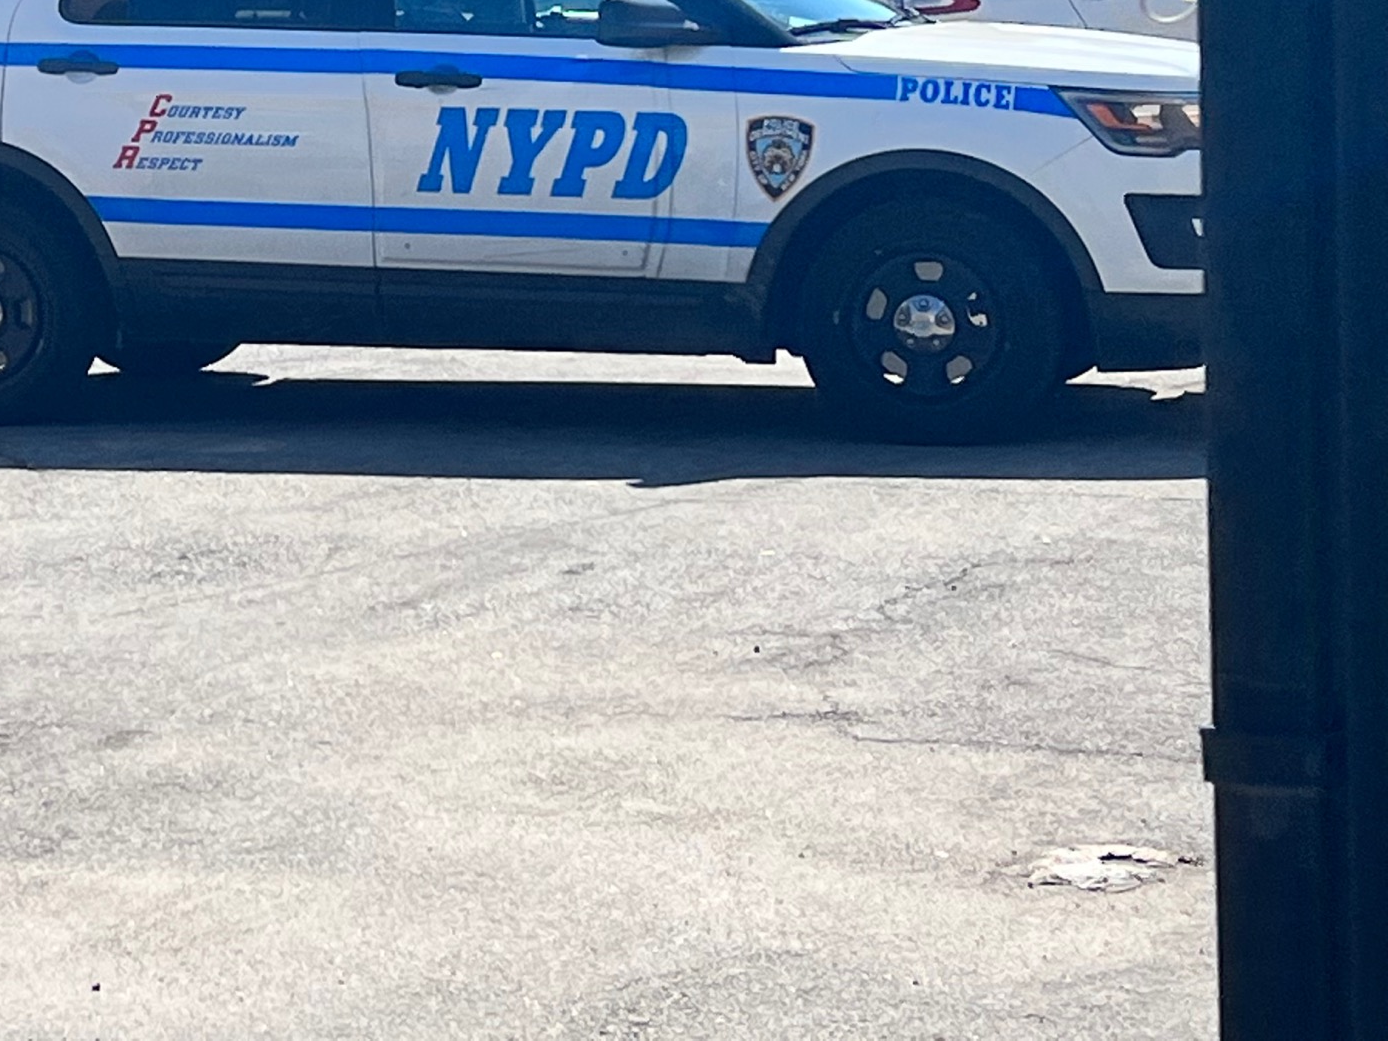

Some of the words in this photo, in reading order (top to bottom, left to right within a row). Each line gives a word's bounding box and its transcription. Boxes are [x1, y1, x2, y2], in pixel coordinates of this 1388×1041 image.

[149, 94, 246, 120] COURTESY
[899, 77, 1012, 111] POLICE
[131, 119, 299, 147] PROFESSIONALISM
[113, 145, 203, 171] RESPECT
[416, 106, 688, 200] NYPD
